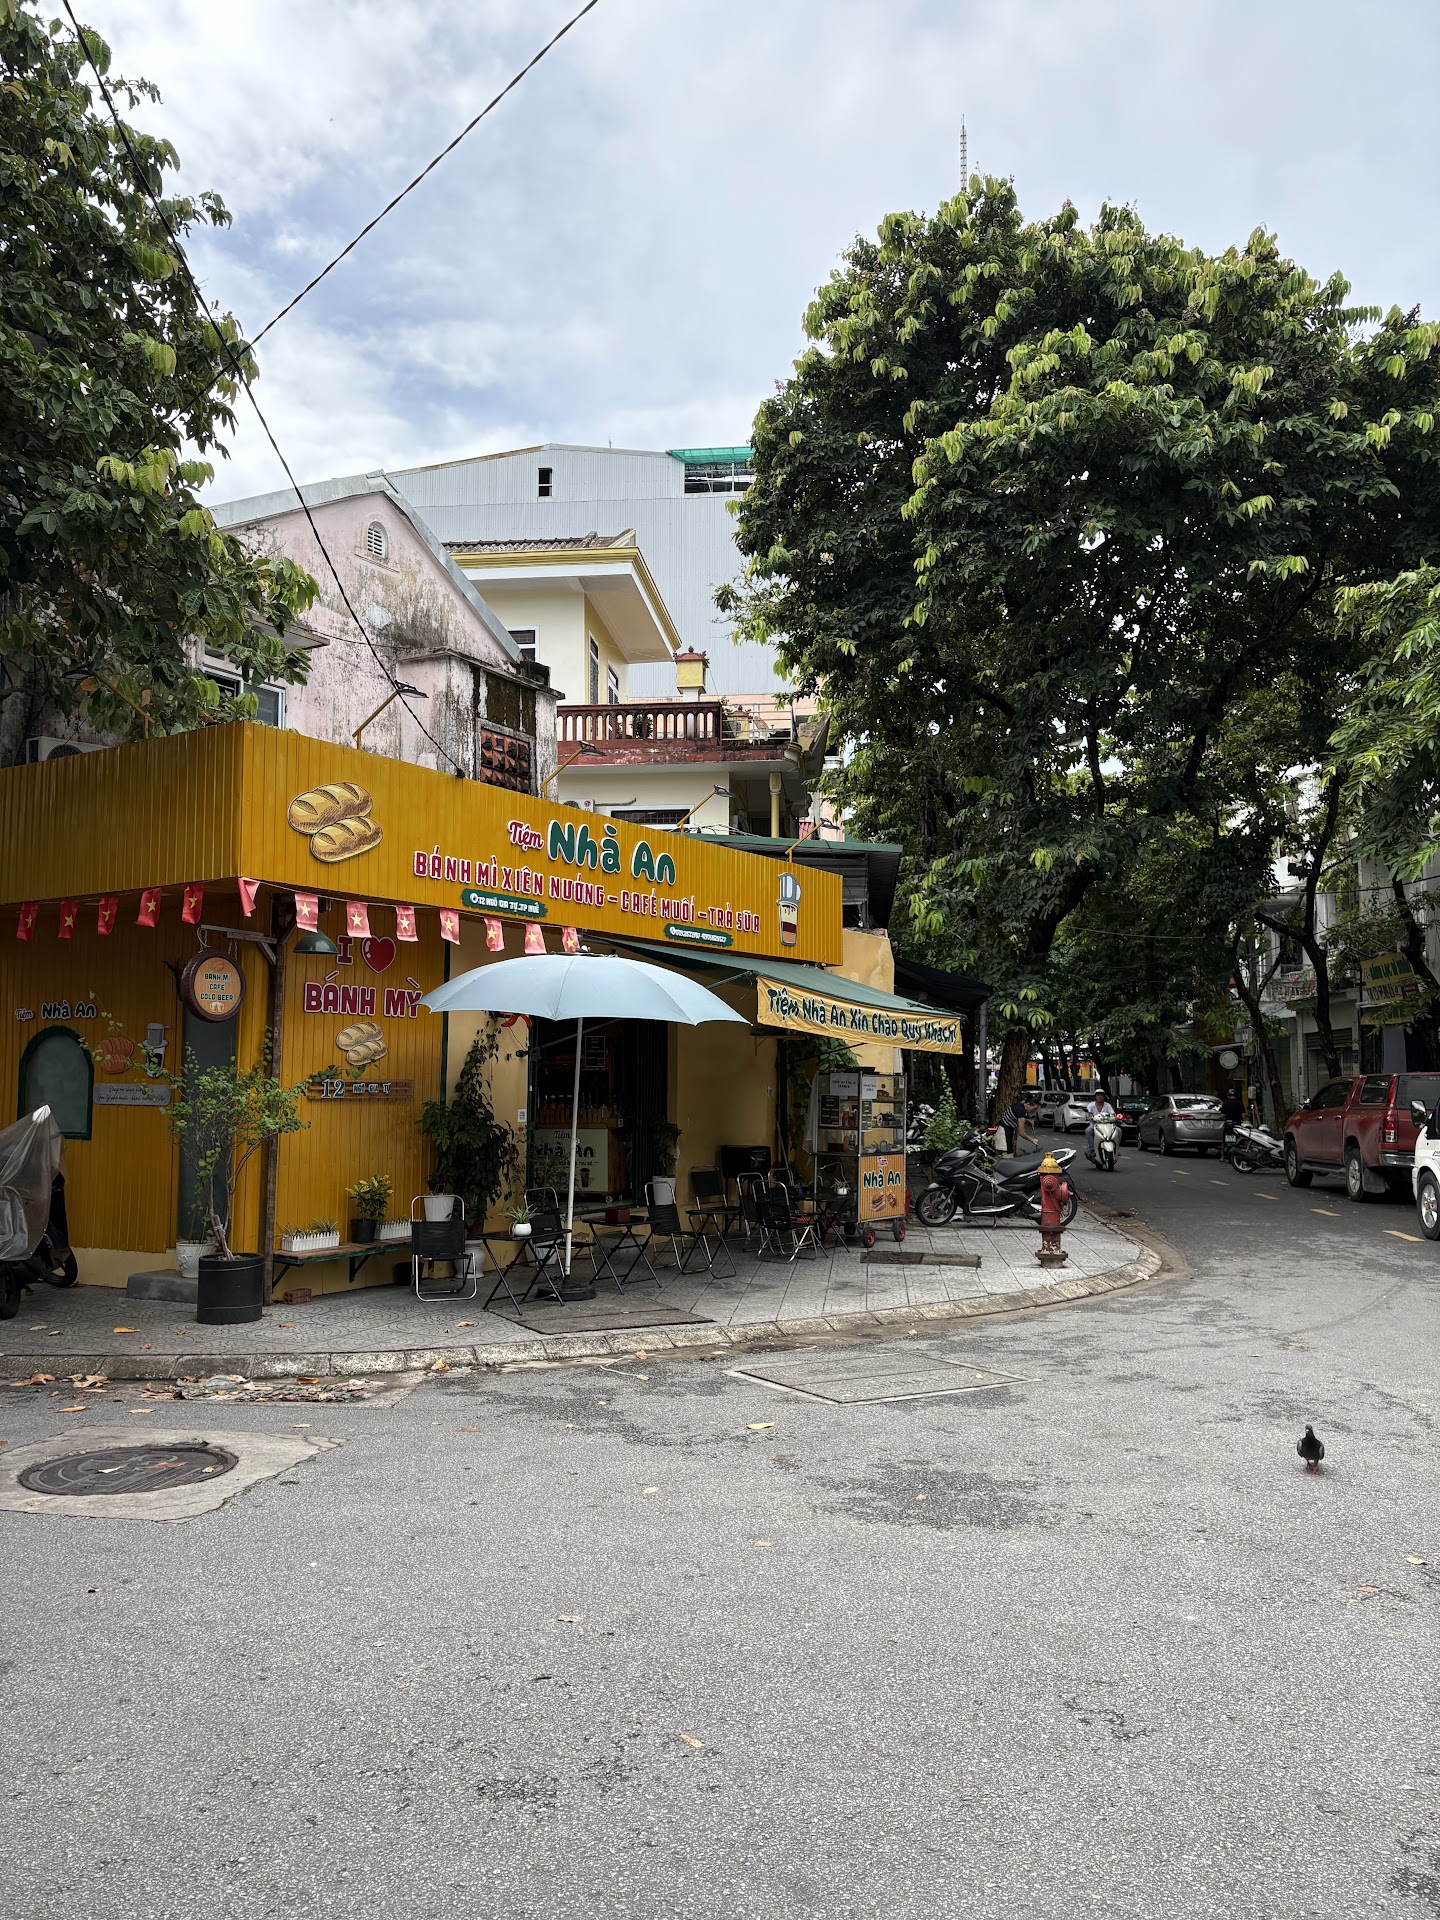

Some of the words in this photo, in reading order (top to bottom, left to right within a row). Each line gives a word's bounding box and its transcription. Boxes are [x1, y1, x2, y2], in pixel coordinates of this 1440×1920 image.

[507, 820, 544, 852] Tiệm
[547, 819, 621, 874] Nhà
[631, 840, 676, 886] An
[414, 844, 471, 883] BÁNH
[475, 855, 498, 888] MÌ
[501, 866, 544, 896] XIÊN
[549, 873, 605, 907] NƯỚNG
[621, 887, 657, 916] CAFÉ
[660, 895, 695, 923] MUỐI
[708, 902, 733, 929] TRÀ
[736, 908, 760, 933] SỮA
[337, 935, 353, 966] I
[41, 1000, 71, 1020] Nhà
[74, 1001, 96, 1019] An
[200, 993, 216, 1001] COLD
[217, 994, 234, 1002] BEER
[304, 970, 376, 1016] BÁNH
[384, 976, 422, 1019] MỲ
[767, 987, 800, 1021] Tiệm
[802, 997, 827, 1027] Nhà
[830, 1004, 847, 1028] An
[849, 1007, 869, 1032] Xin
[871, 1011, 898, 1038] Chào
[900, 1018, 922, 1046] Quý
[321, 1079, 345, 1099] 12
[863, 1168, 884, 1189] Nhà
[887, 1169, 901, 1187] An
